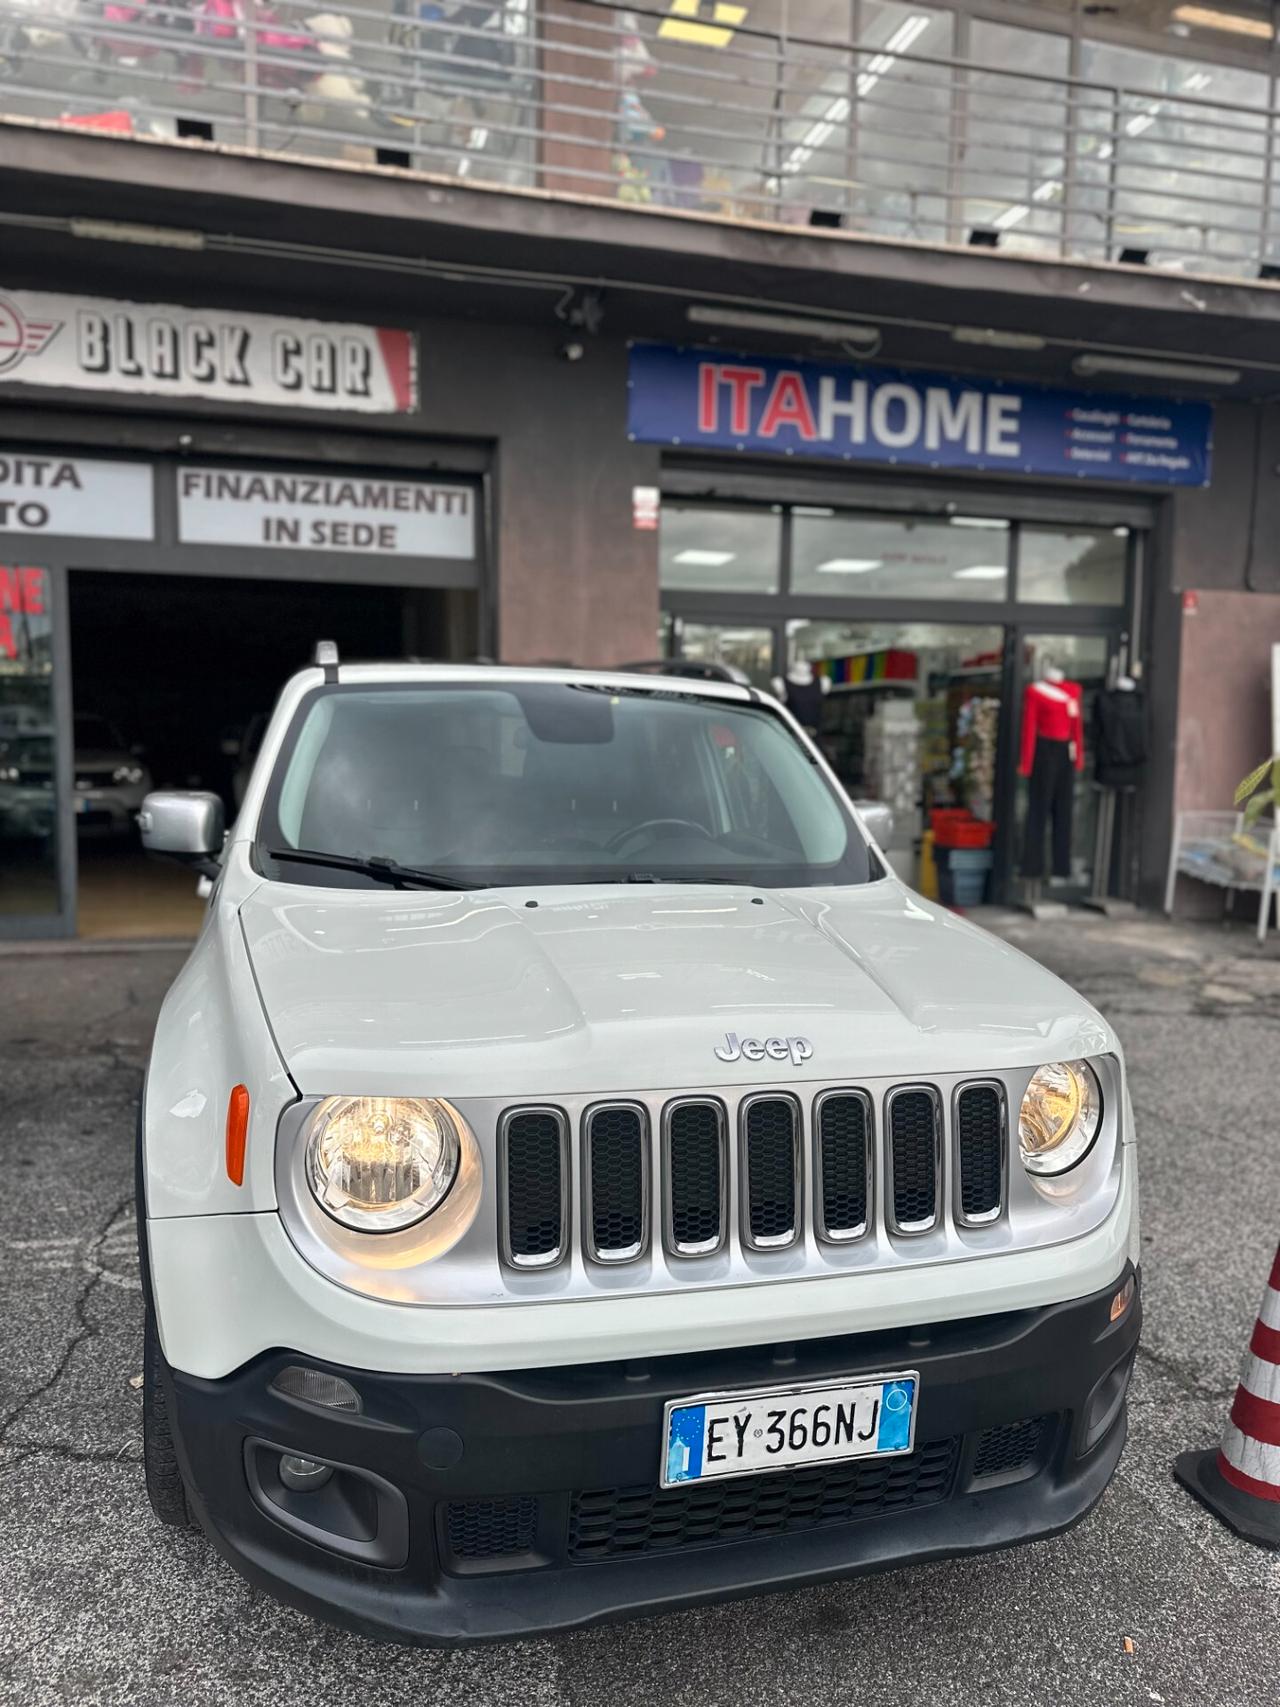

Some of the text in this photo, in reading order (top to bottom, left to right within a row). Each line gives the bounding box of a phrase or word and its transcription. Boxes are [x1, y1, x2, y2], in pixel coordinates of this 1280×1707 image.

[77, 311, 371, 396] BLACK CAR
[699, 362, 1021, 458] ITAHOME
[183, 472, 467, 516] FINANZIAMENTI
[263, 517, 397, 549] IN SEDE
[714, 1032, 814, 1066] Jeep
